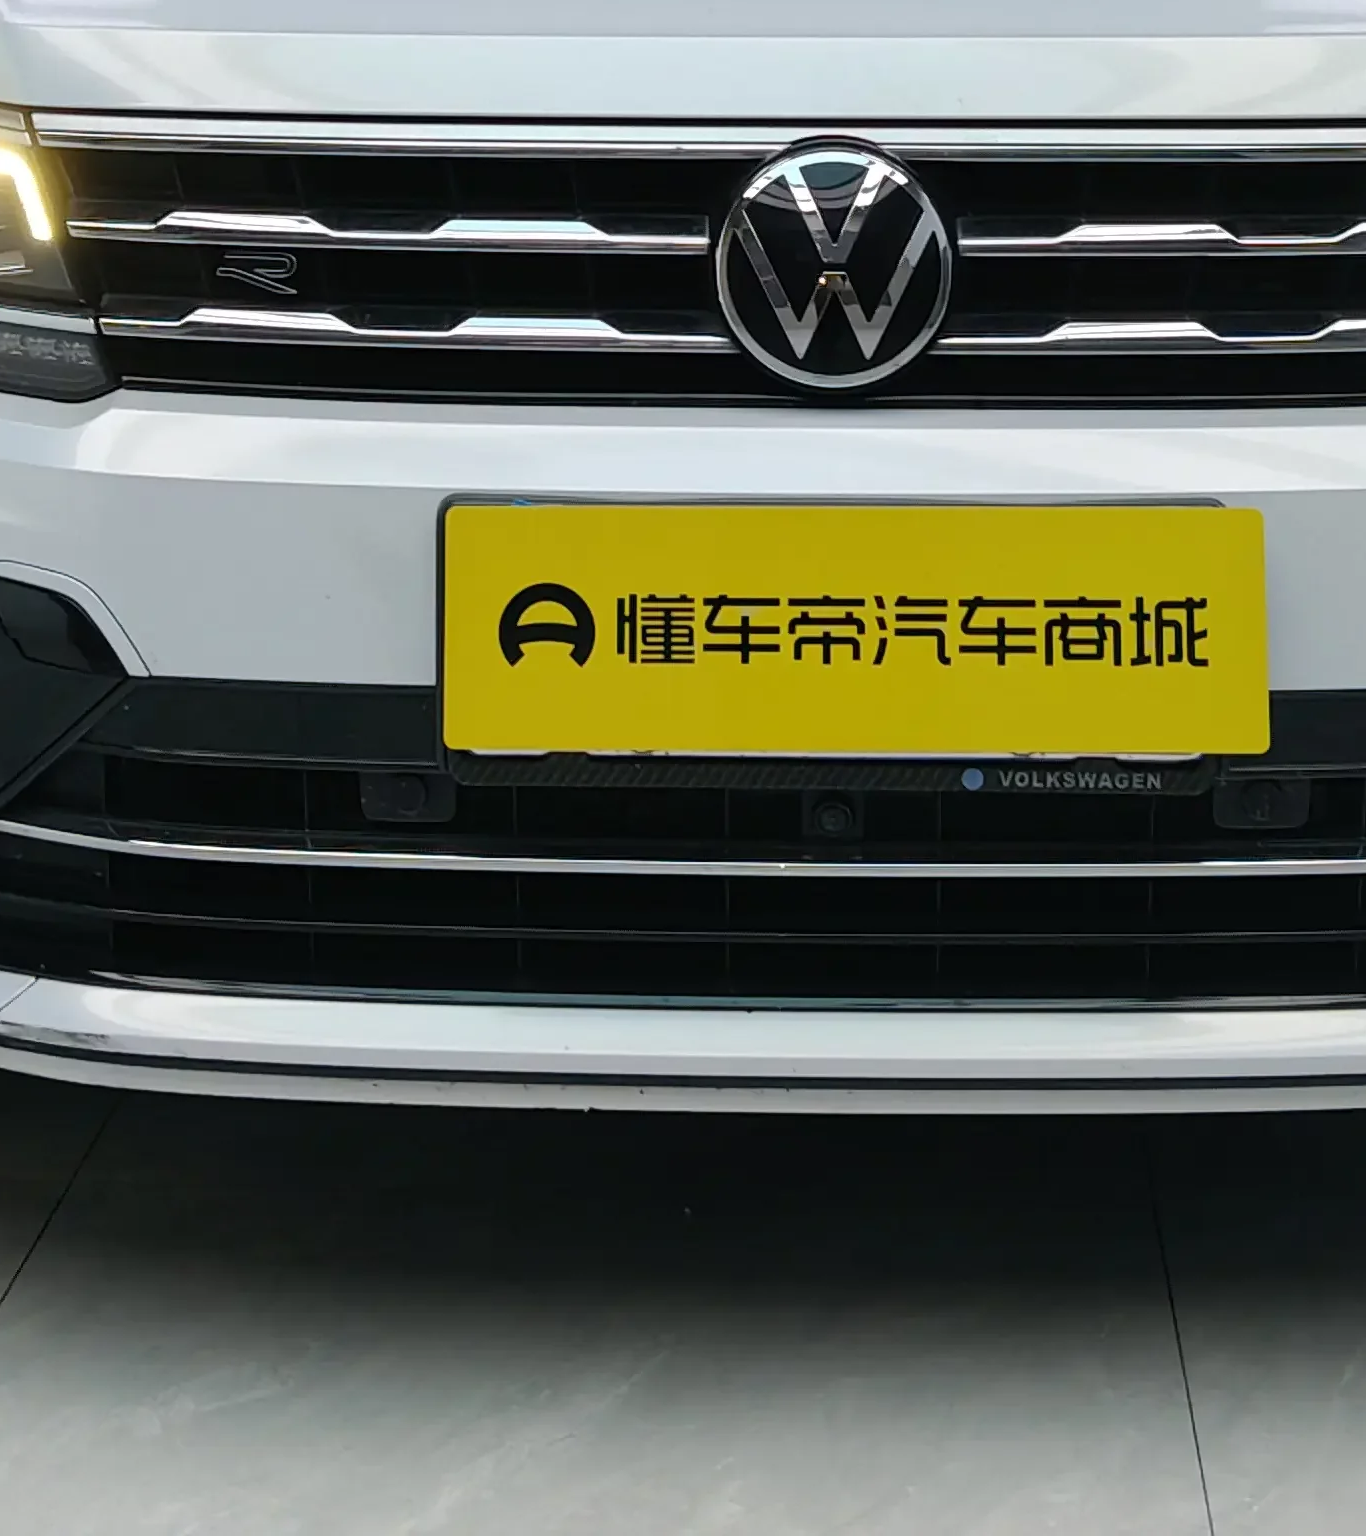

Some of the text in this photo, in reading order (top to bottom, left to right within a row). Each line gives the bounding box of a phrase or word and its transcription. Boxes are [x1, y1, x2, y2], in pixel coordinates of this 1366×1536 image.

[616, 594, 1210, 669] 懂车帝汽车商城
[998, 770, 1163, 790] VOLKSWAGEN
